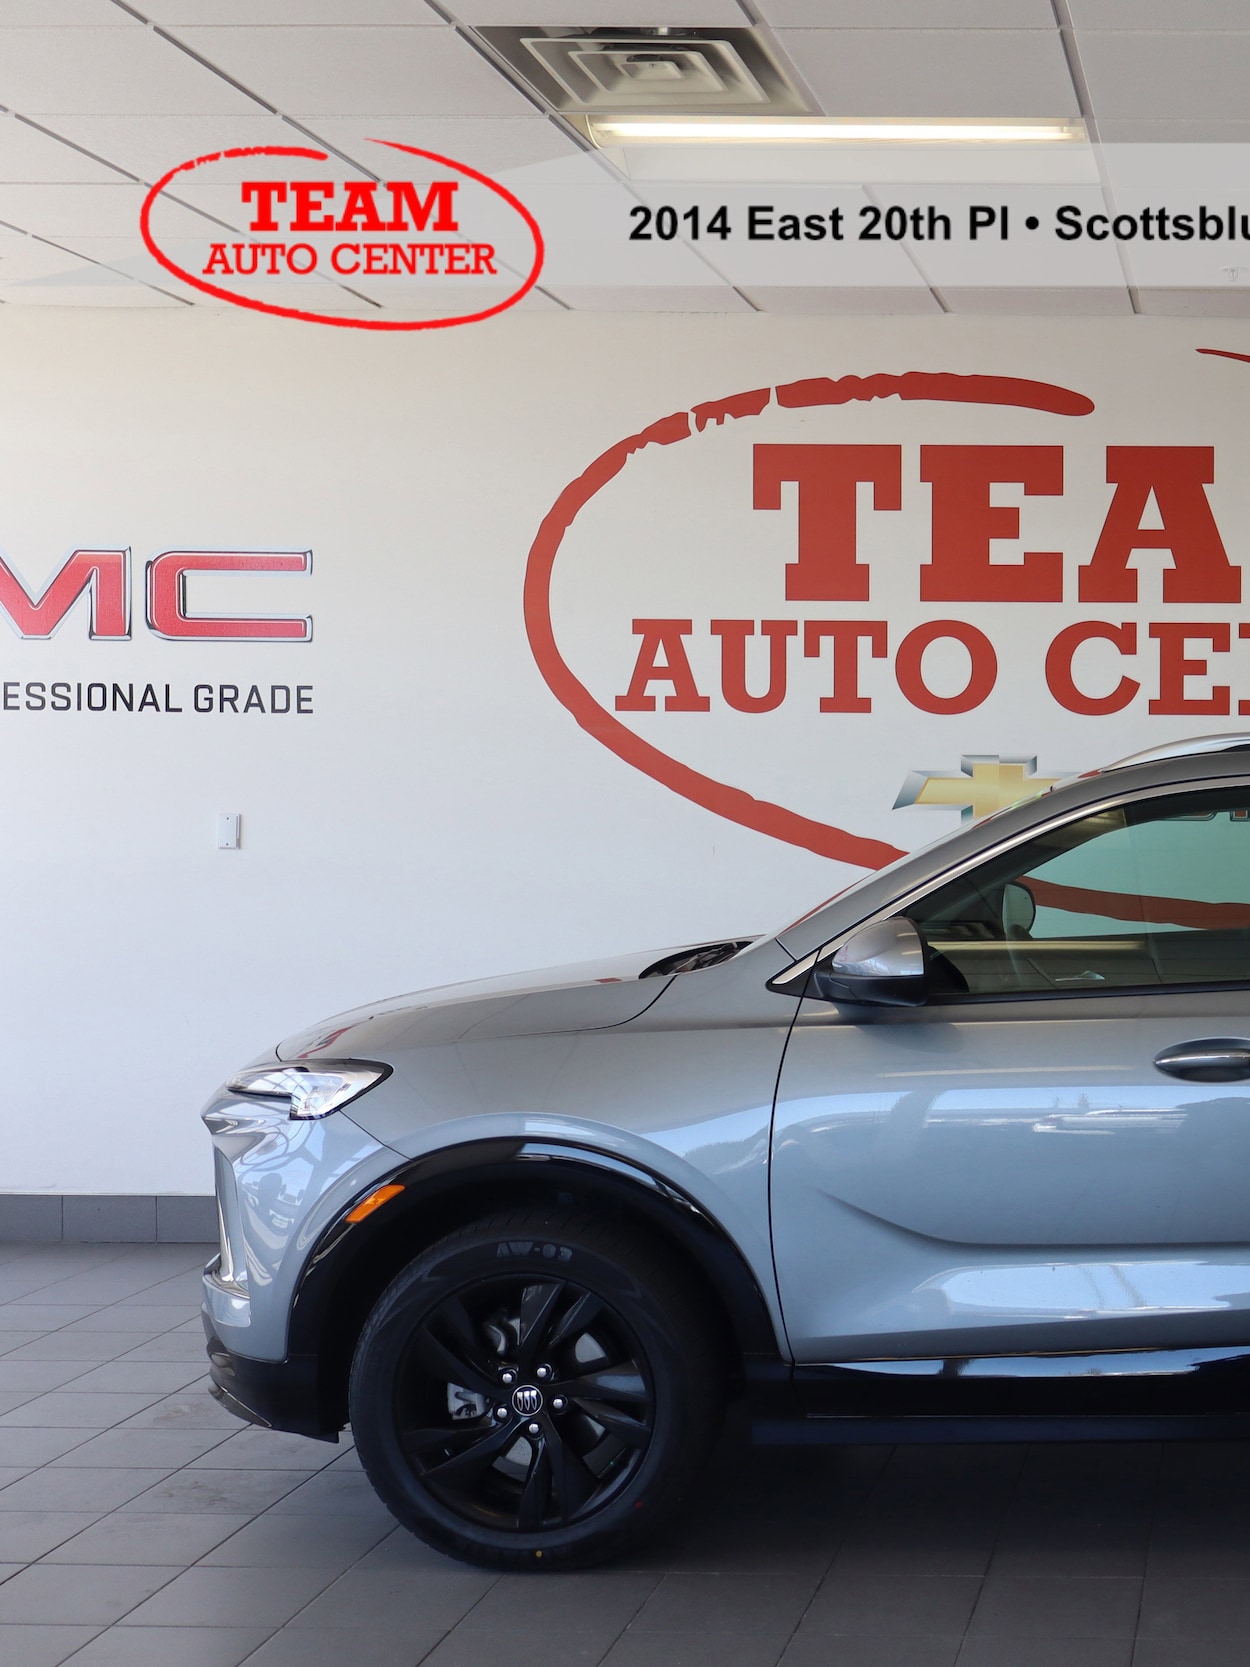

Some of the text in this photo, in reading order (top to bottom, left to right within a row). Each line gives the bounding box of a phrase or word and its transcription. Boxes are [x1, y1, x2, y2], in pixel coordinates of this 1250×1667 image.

[3, 682, 314, 714] ESSIONAL GRADE
[615, 619, 998, 714] AUTO
